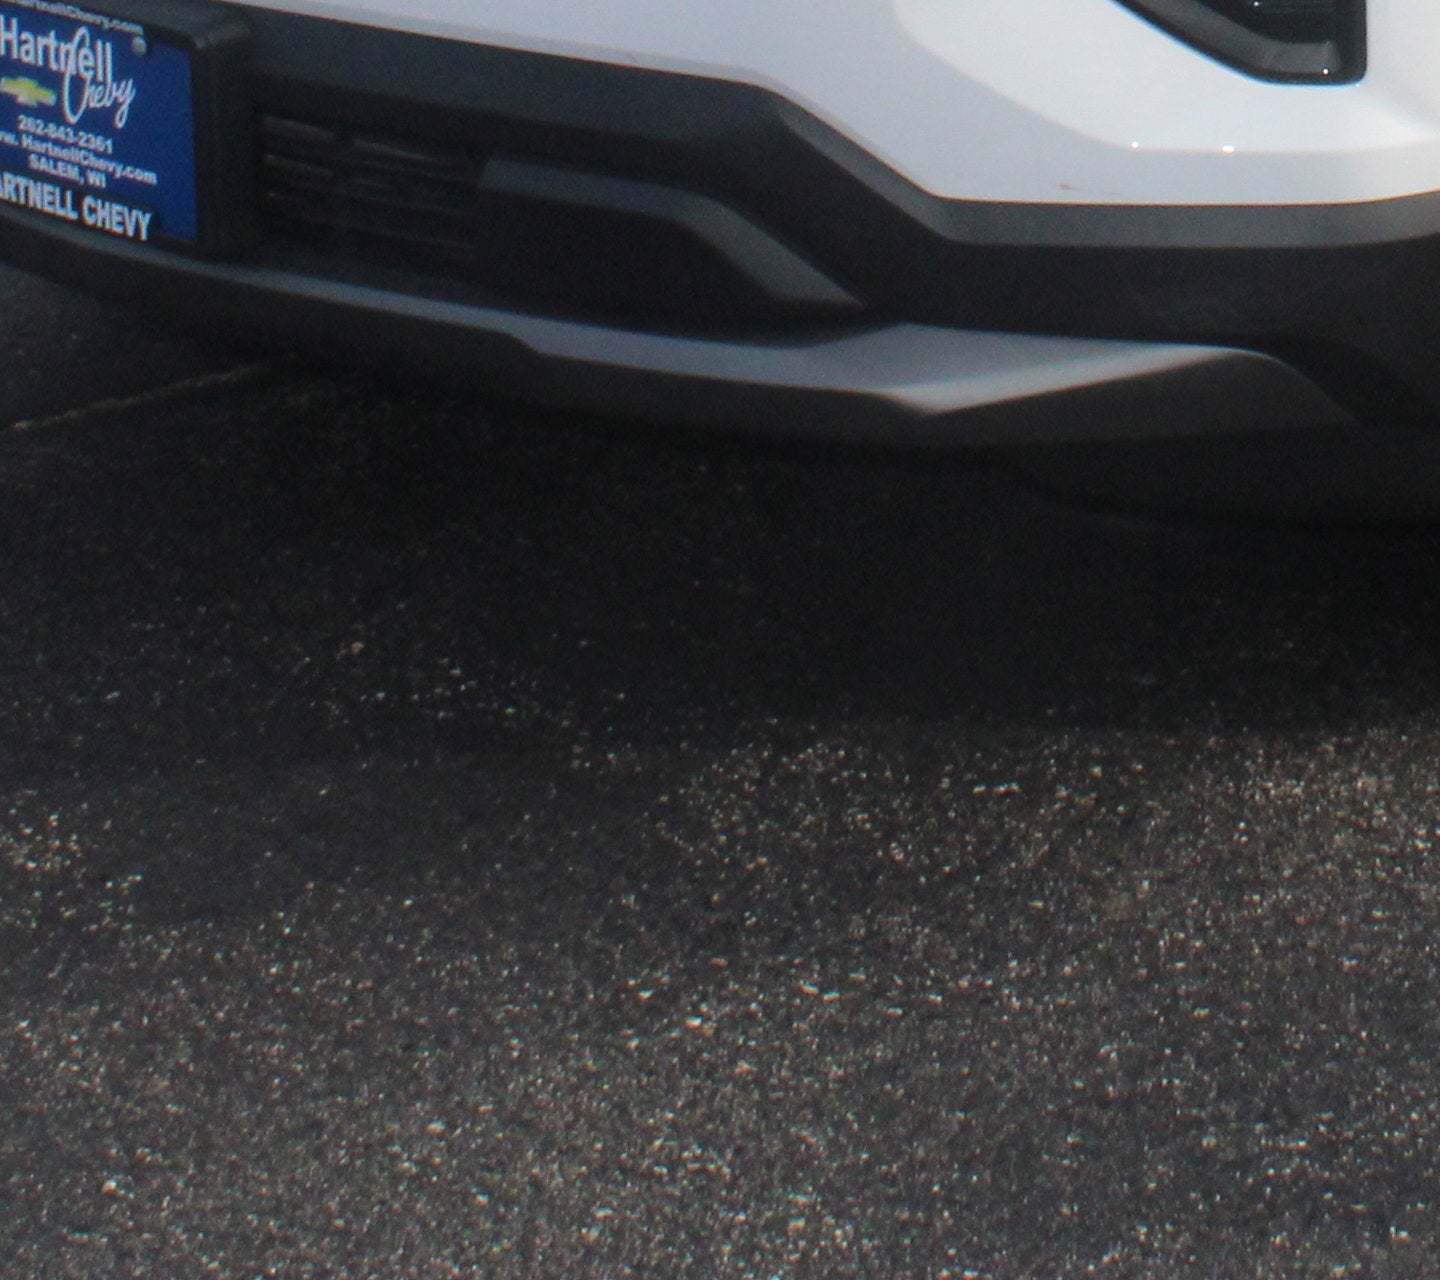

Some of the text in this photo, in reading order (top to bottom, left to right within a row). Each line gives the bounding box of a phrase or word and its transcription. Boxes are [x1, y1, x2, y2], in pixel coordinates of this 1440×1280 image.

[62, 25, 137, 130] Chevy
[28, 153, 107, 189] SALEM, WI
[83, 195, 152, 241] CHEVY
